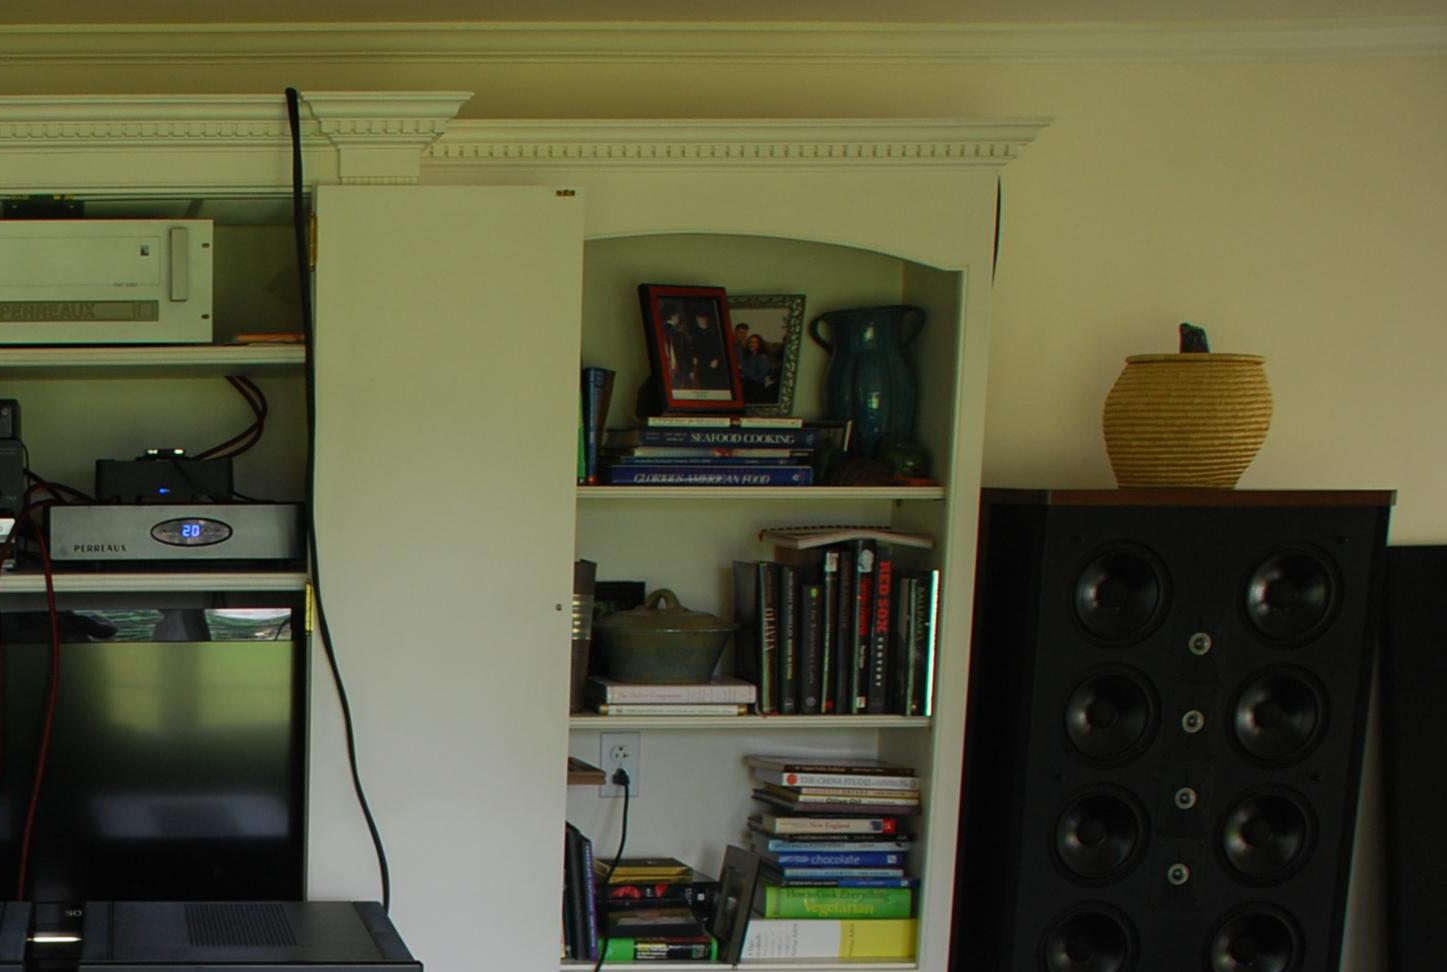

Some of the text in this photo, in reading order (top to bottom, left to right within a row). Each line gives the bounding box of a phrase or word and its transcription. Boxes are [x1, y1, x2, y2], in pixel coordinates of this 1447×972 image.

[0, 303, 96, 320] PERREAUX
[691, 433, 741, 443] SEAFOOD
[744, 433, 795, 444] COOKING
[742, 474, 770, 483] FOOD
[182, 525, 200, 537] 20
[73, 544, 127, 553] PERREAUX
[875, 560, 892, 688] RED SOX CENTURY
[817, 777, 842, 785] CHINA
[811, 855, 861, 865] chocolate
[803, 898, 874, 917] Vegetarian
